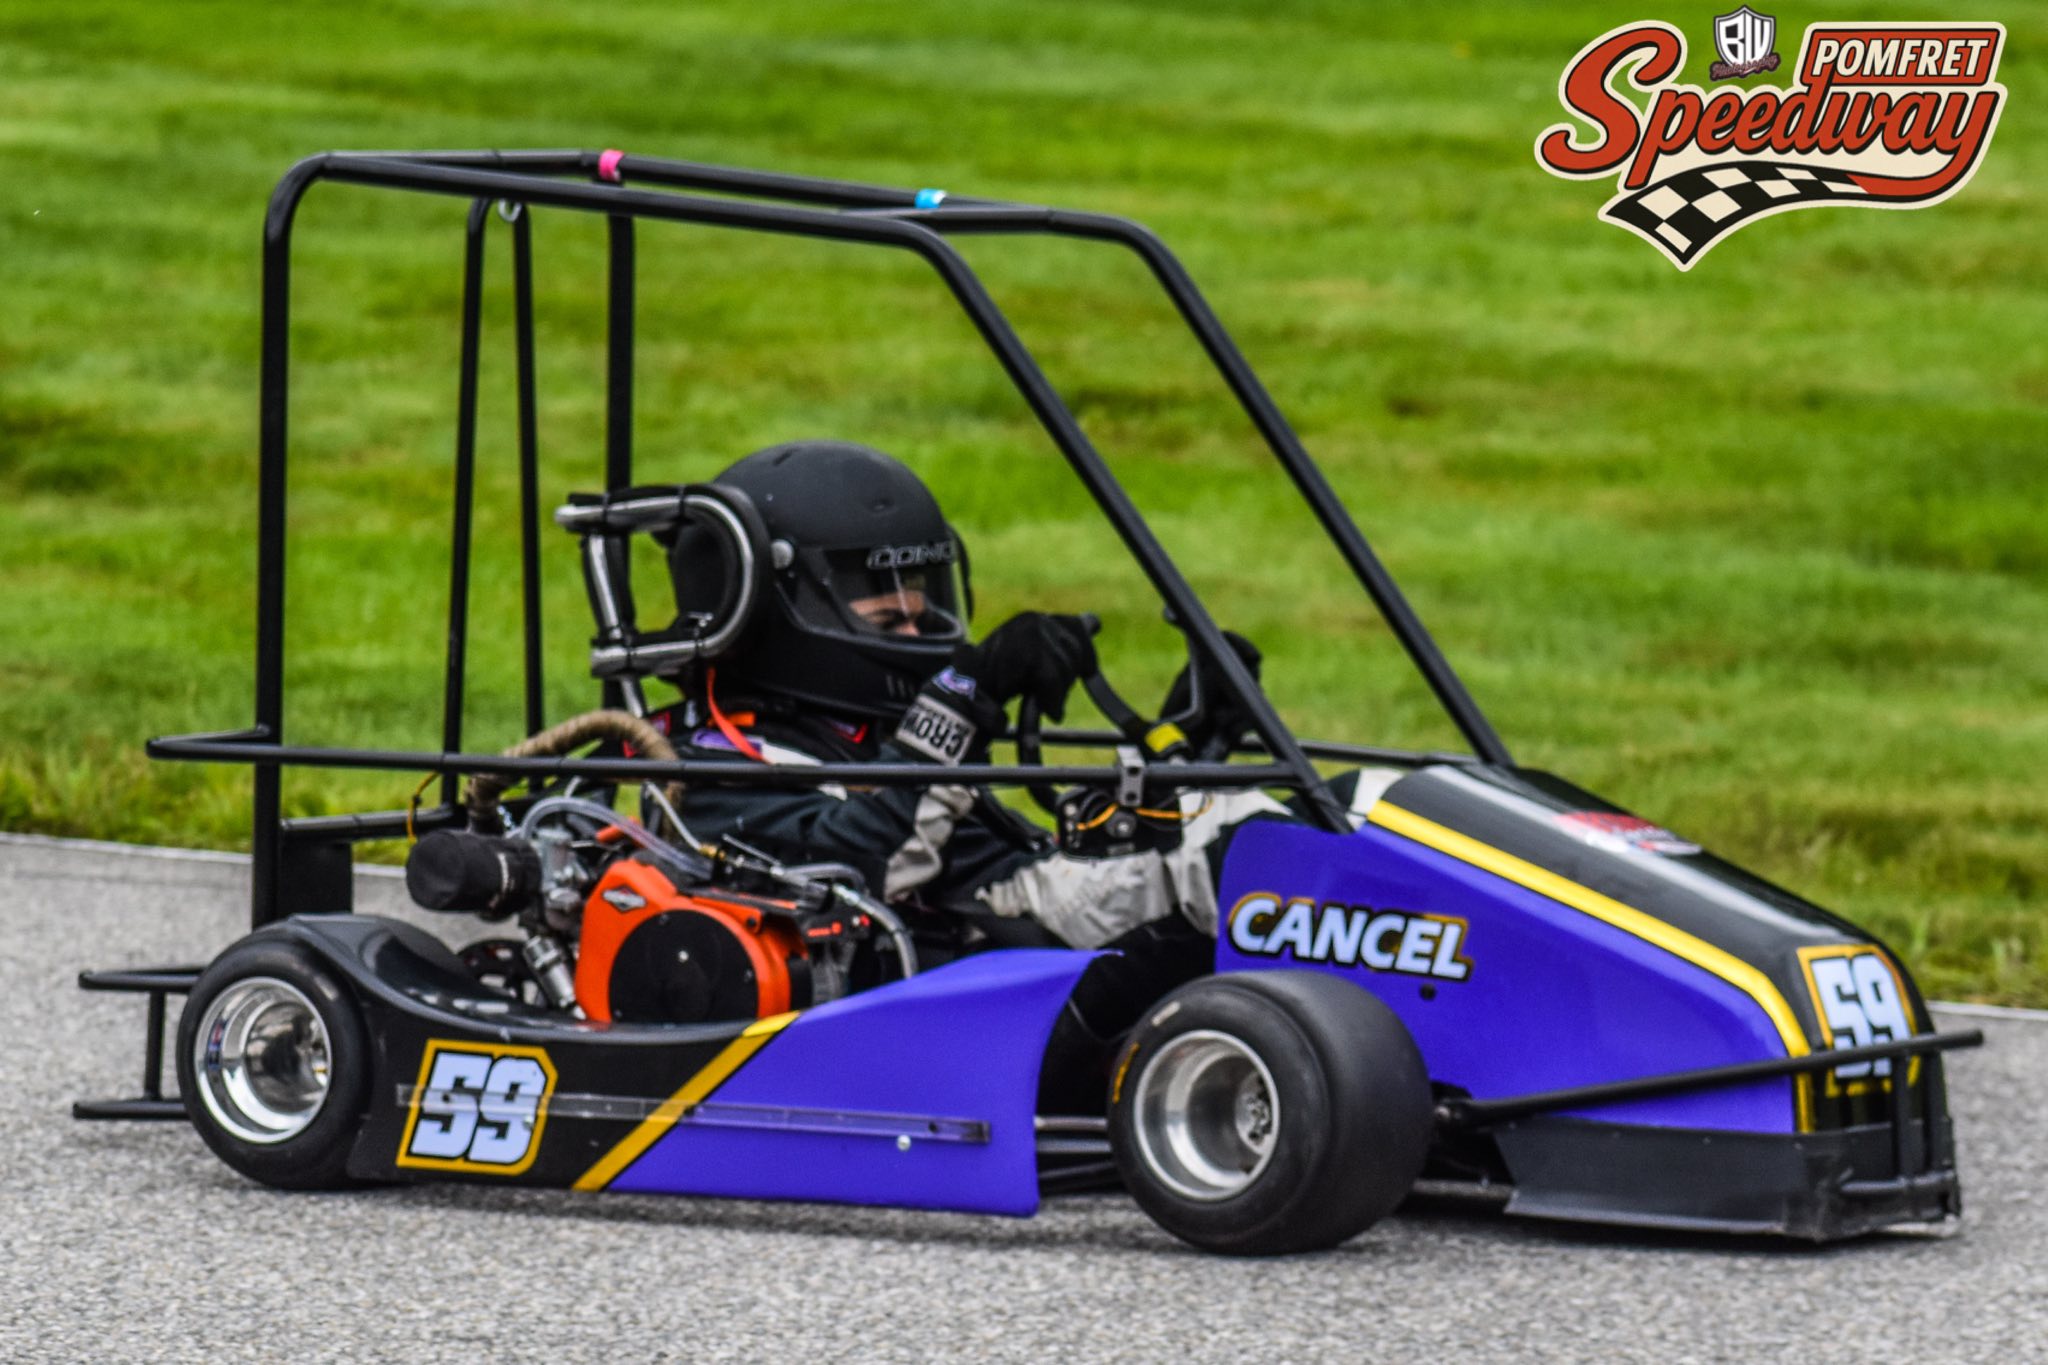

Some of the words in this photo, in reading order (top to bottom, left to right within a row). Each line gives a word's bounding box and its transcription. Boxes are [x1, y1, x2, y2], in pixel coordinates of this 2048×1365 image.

[1230, 895, 1471, 980] CANCEL
[1811, 954, 1912, 1078] 59
[409, 1051, 548, 1165] 59
